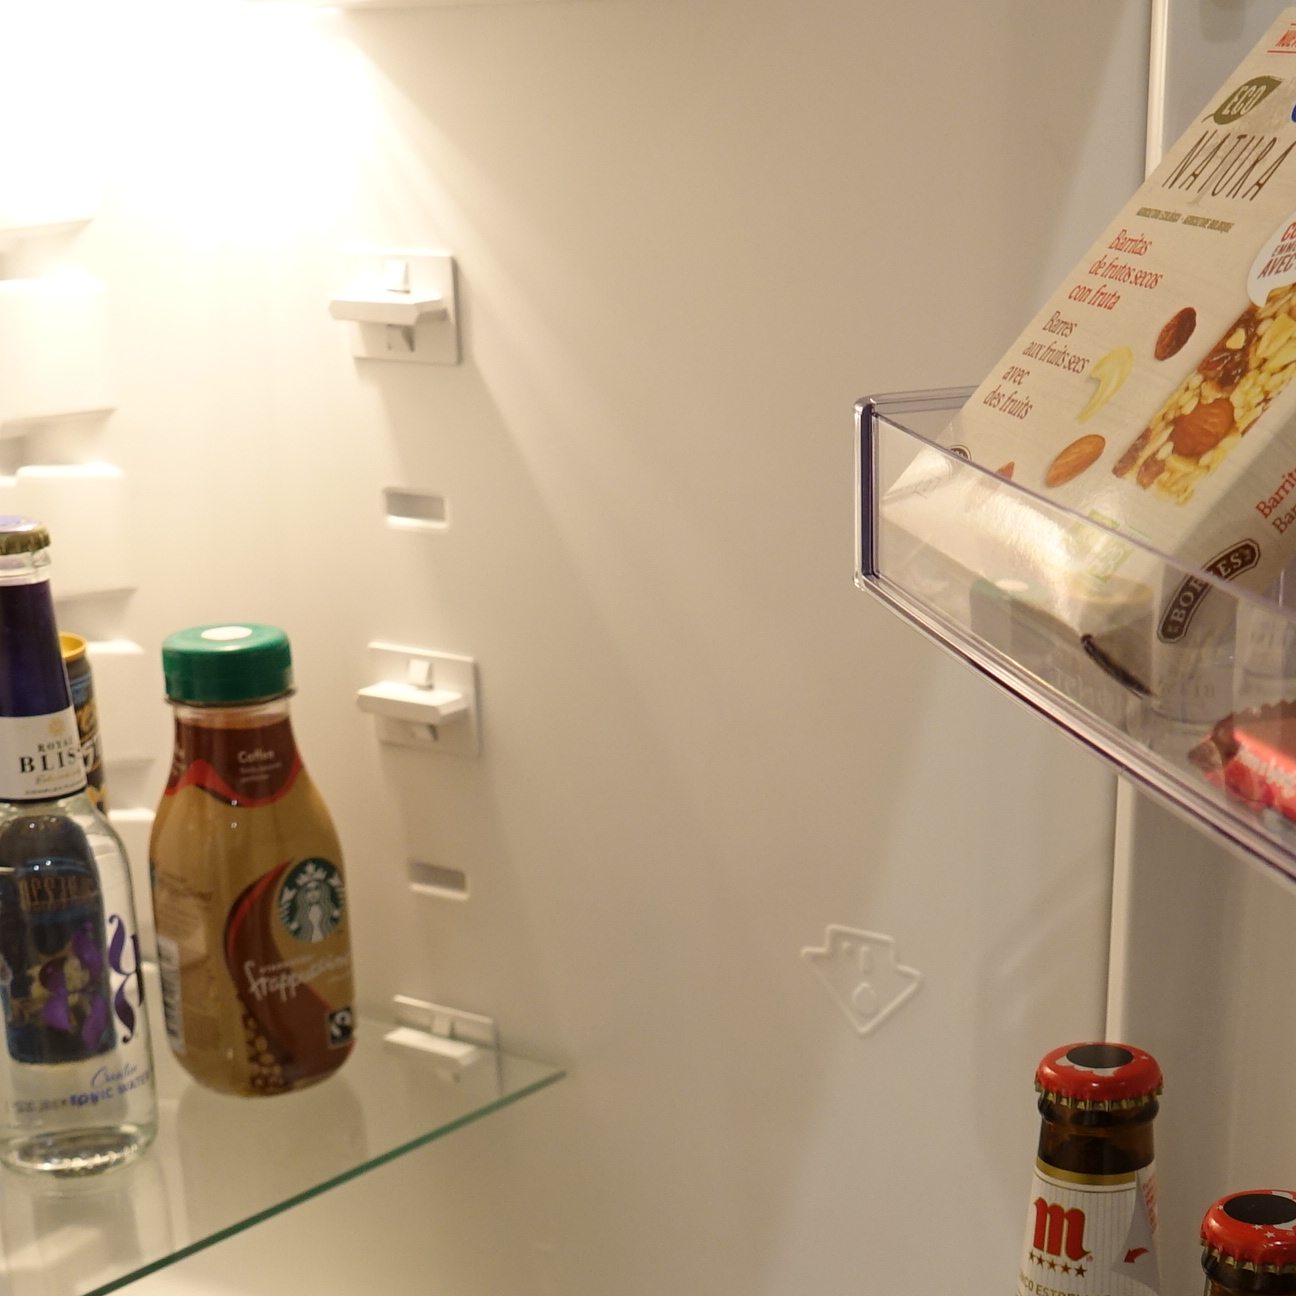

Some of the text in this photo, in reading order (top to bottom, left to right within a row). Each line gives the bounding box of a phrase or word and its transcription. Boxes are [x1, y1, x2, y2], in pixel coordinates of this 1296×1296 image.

[1221, 92, 1258, 116] ECO
[1161, 130, 1296, 201] NATURA
[1108, 229, 1152, 256] Barritas
[1088, 254, 1163, 290] de frutos secos
[1068, 283, 1121, 311] con fruta
[1042, 310, 1077, 338] Barres
[1022, 340, 1090, 375] aux fruits secs
[1002, 364, 1031, 386] avec
[983, 384, 1033, 420] des fruits
[1170, 552, 1242, 623] BOES
